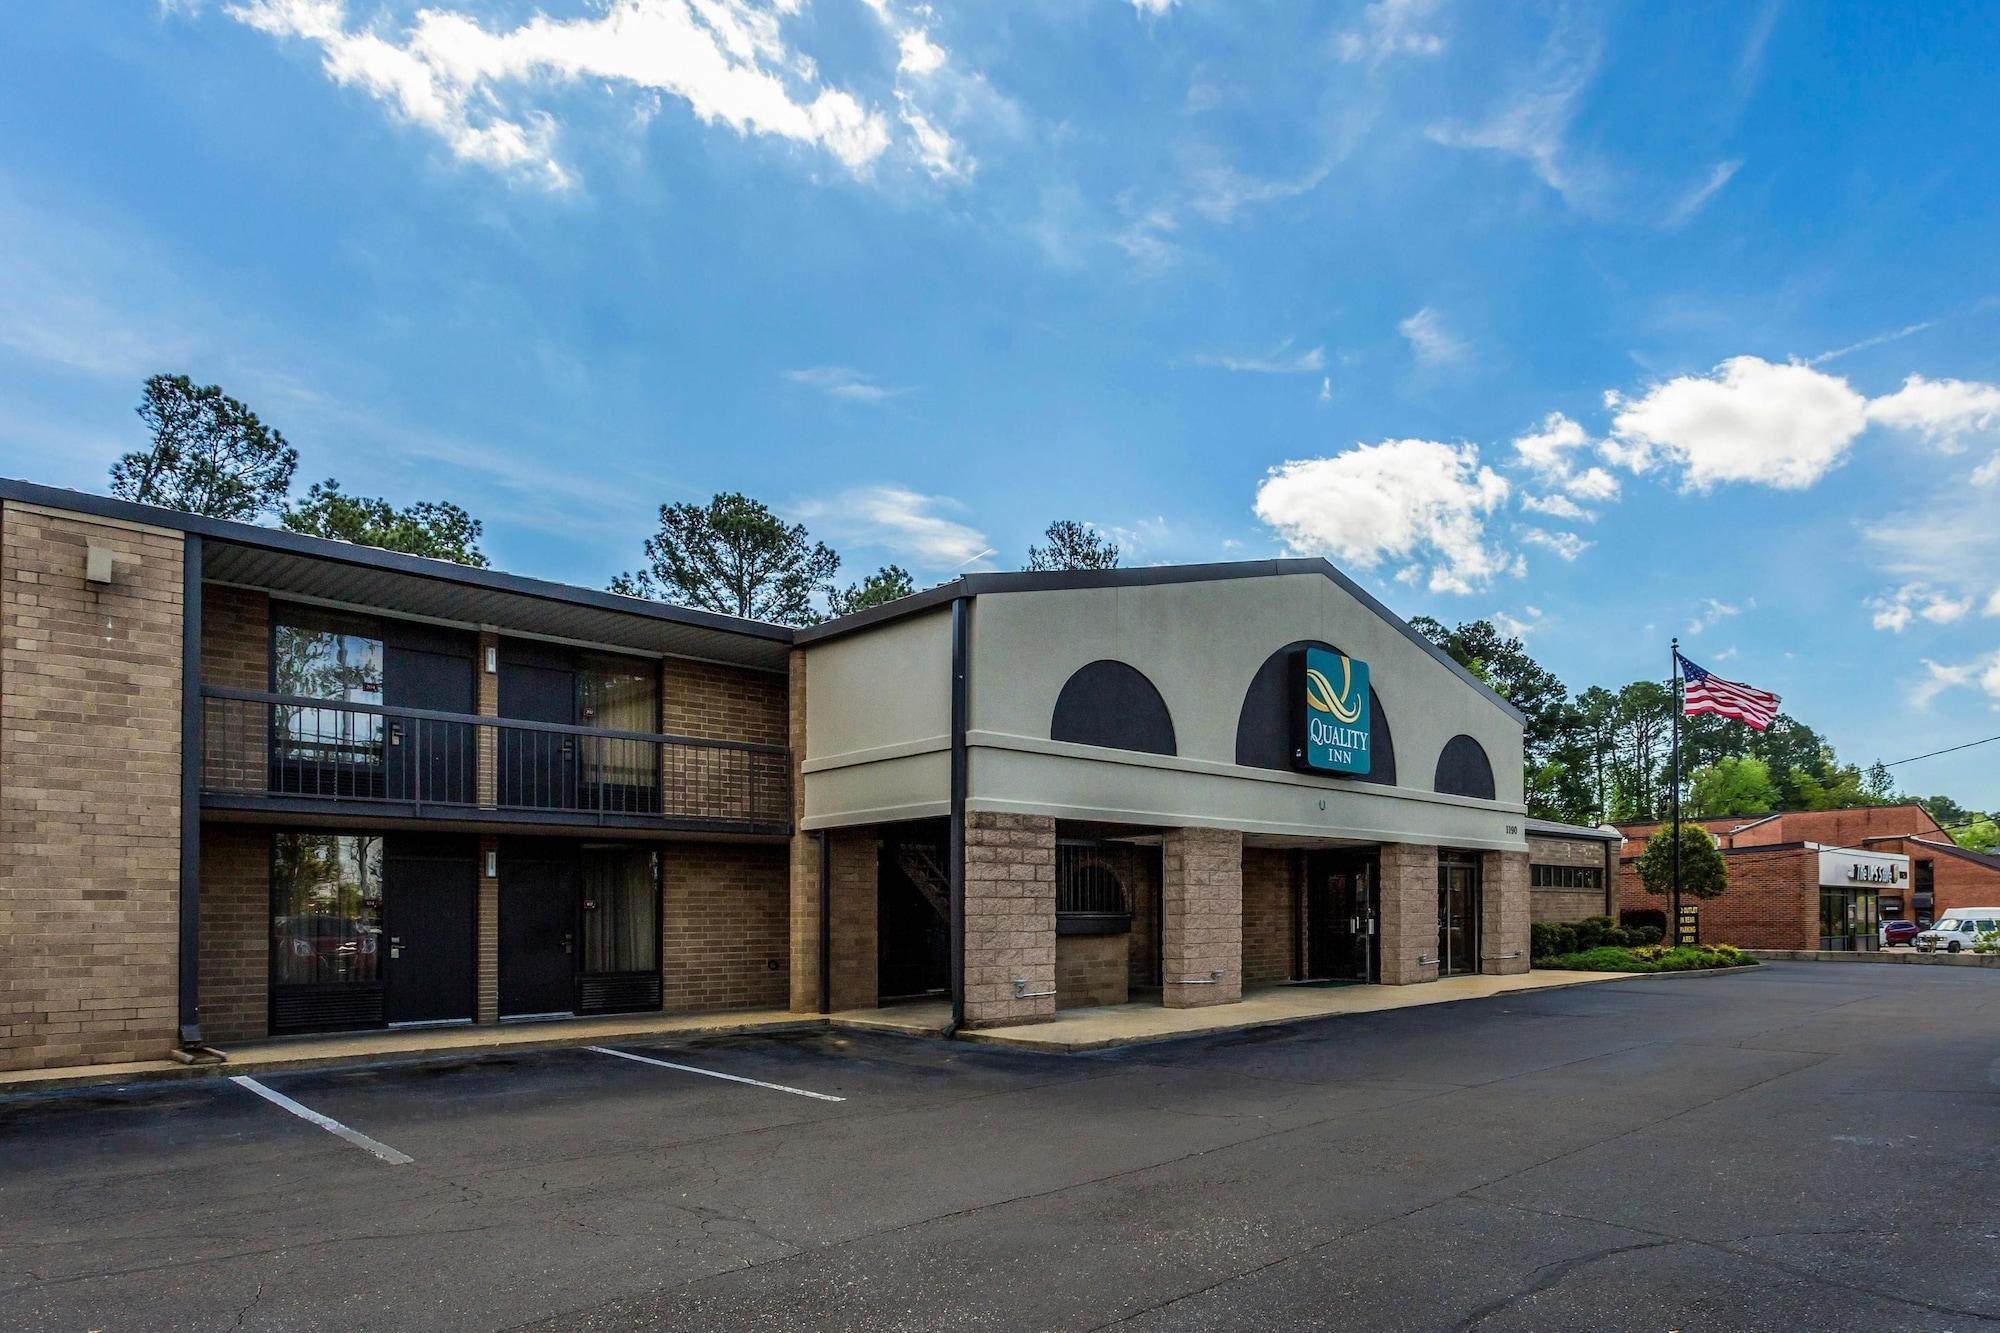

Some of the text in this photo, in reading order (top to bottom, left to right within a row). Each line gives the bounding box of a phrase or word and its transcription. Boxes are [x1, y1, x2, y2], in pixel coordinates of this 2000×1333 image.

[1310, 717, 1369, 751] QUALITY
[1328, 748, 1352, 764] INN
[1505, 825, 1518, 835] 1190
